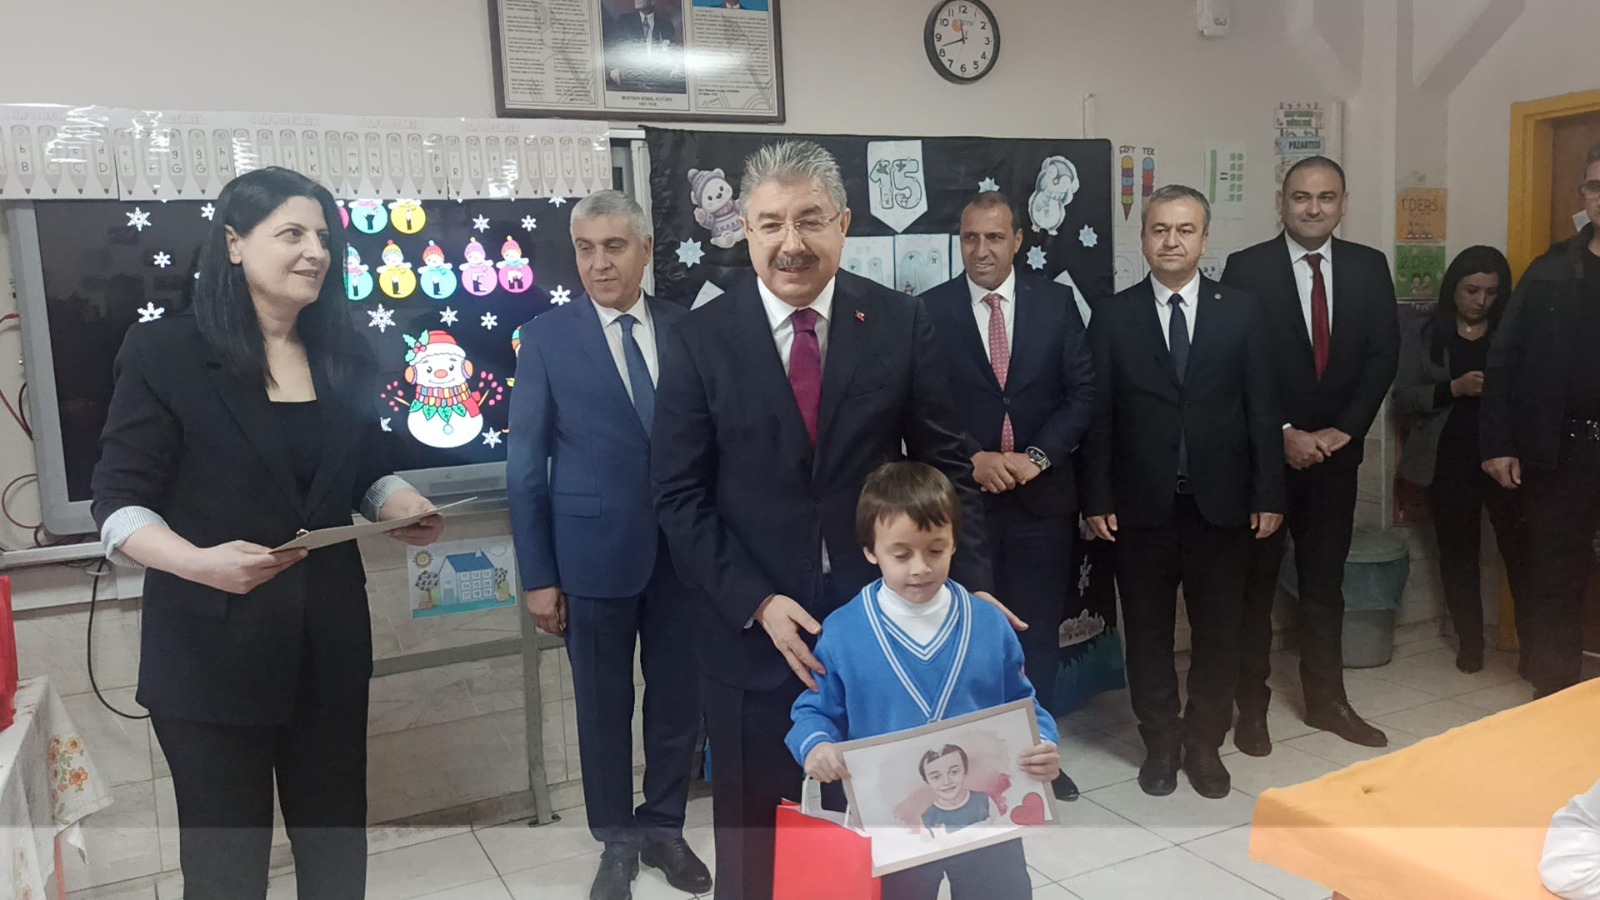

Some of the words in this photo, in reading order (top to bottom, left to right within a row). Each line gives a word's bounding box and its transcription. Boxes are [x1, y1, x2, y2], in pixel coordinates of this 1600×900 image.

[948, 8, 954, 17] 11
[959, 5, 968, 14] 12
[940, 18, 949, 27] 10
[980, 21, 987, 30] 2
[935, 32, 942, 42] 9
[984, 37, 991, 46] 3
[939, 48, 946, 58] 8
[981, 51, 987, 60] 4
[947, 59, 954, 68] 7
[973, 60, 979, 70] 5
[960, 64, 967, 73] 6
[1142, 147, 1155, 155] TEK
[21, 161, 29, 172] B
[99, 162, 108, 173] D
[171, 163, 182, 174] G
[219, 164, 229, 173] H
[870, 159, 923, 209] 15
